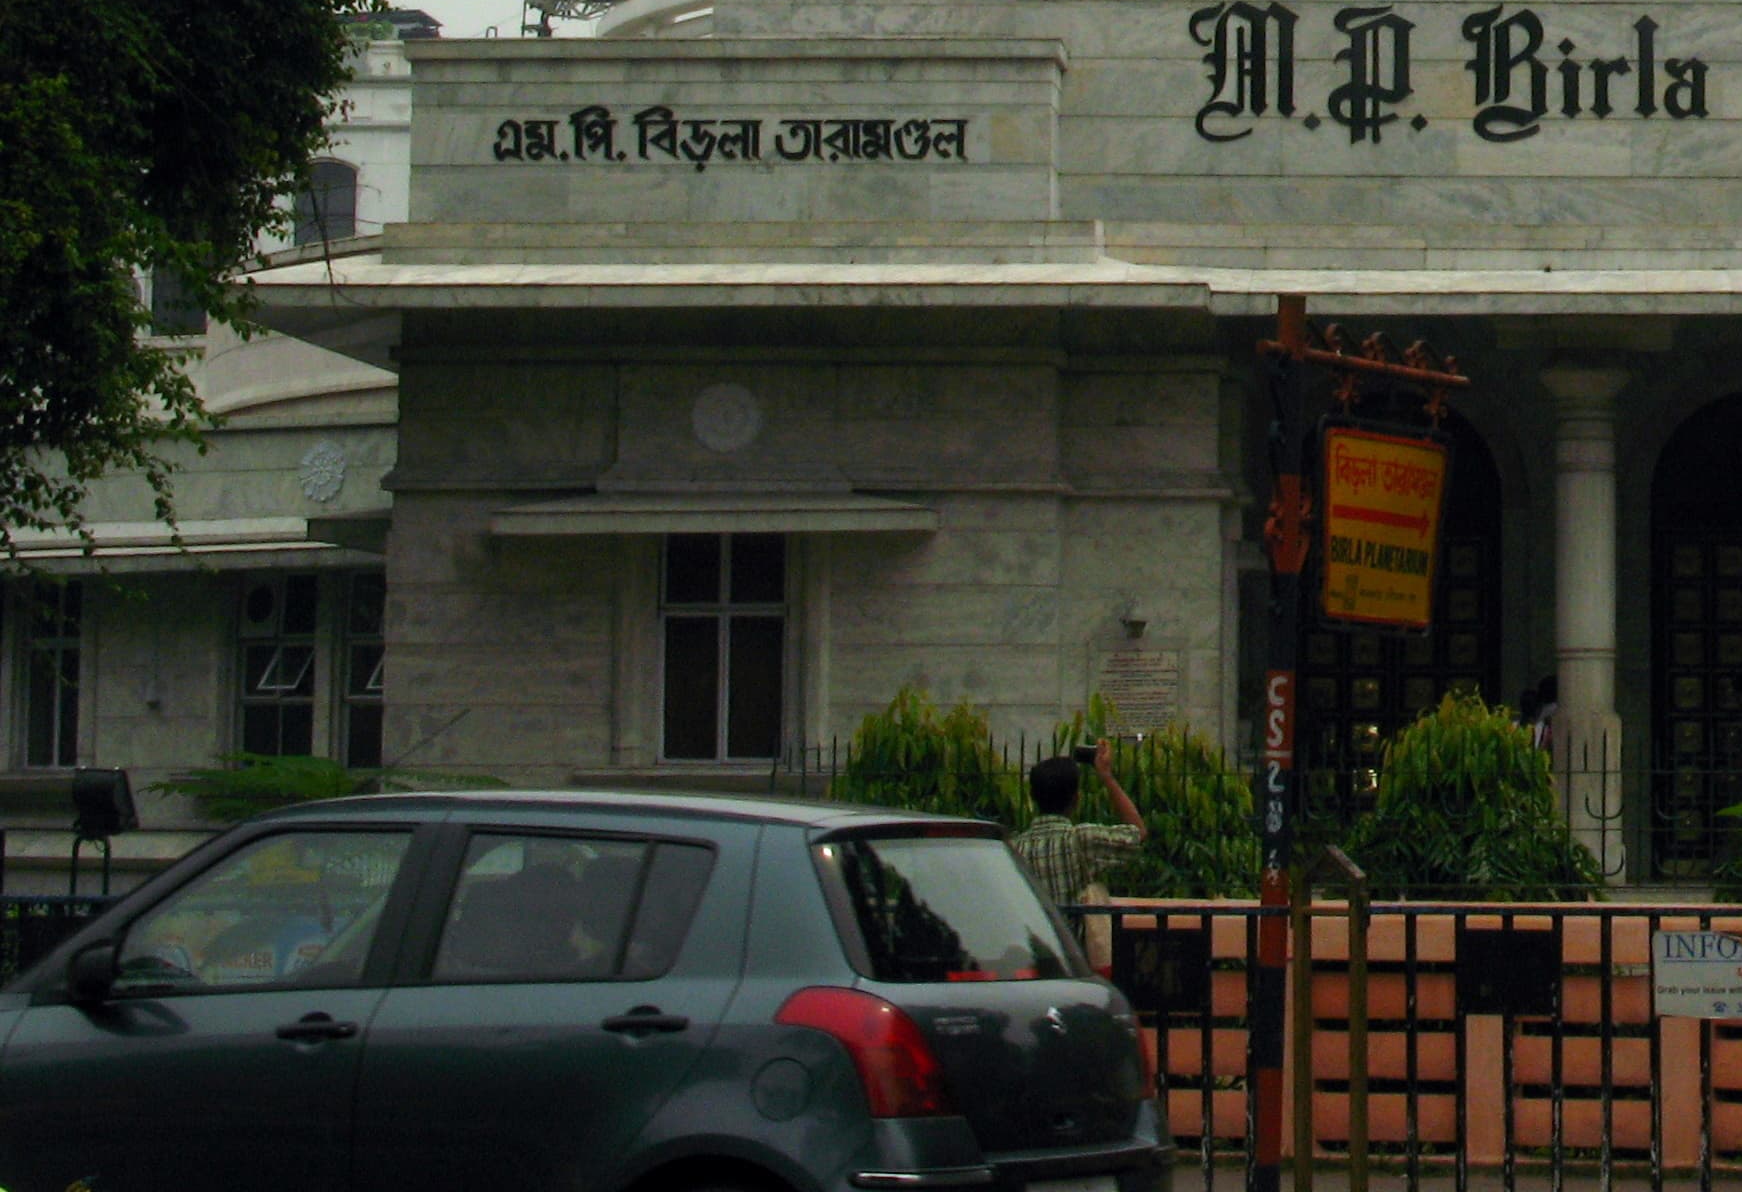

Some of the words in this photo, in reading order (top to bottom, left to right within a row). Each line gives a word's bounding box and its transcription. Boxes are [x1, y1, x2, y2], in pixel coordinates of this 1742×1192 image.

[1462, 2, 1709, 143] Birla
[775, 119, 968, 162] তারামণ্ডল
[1331, 535, 1362, 565] BIRLA
